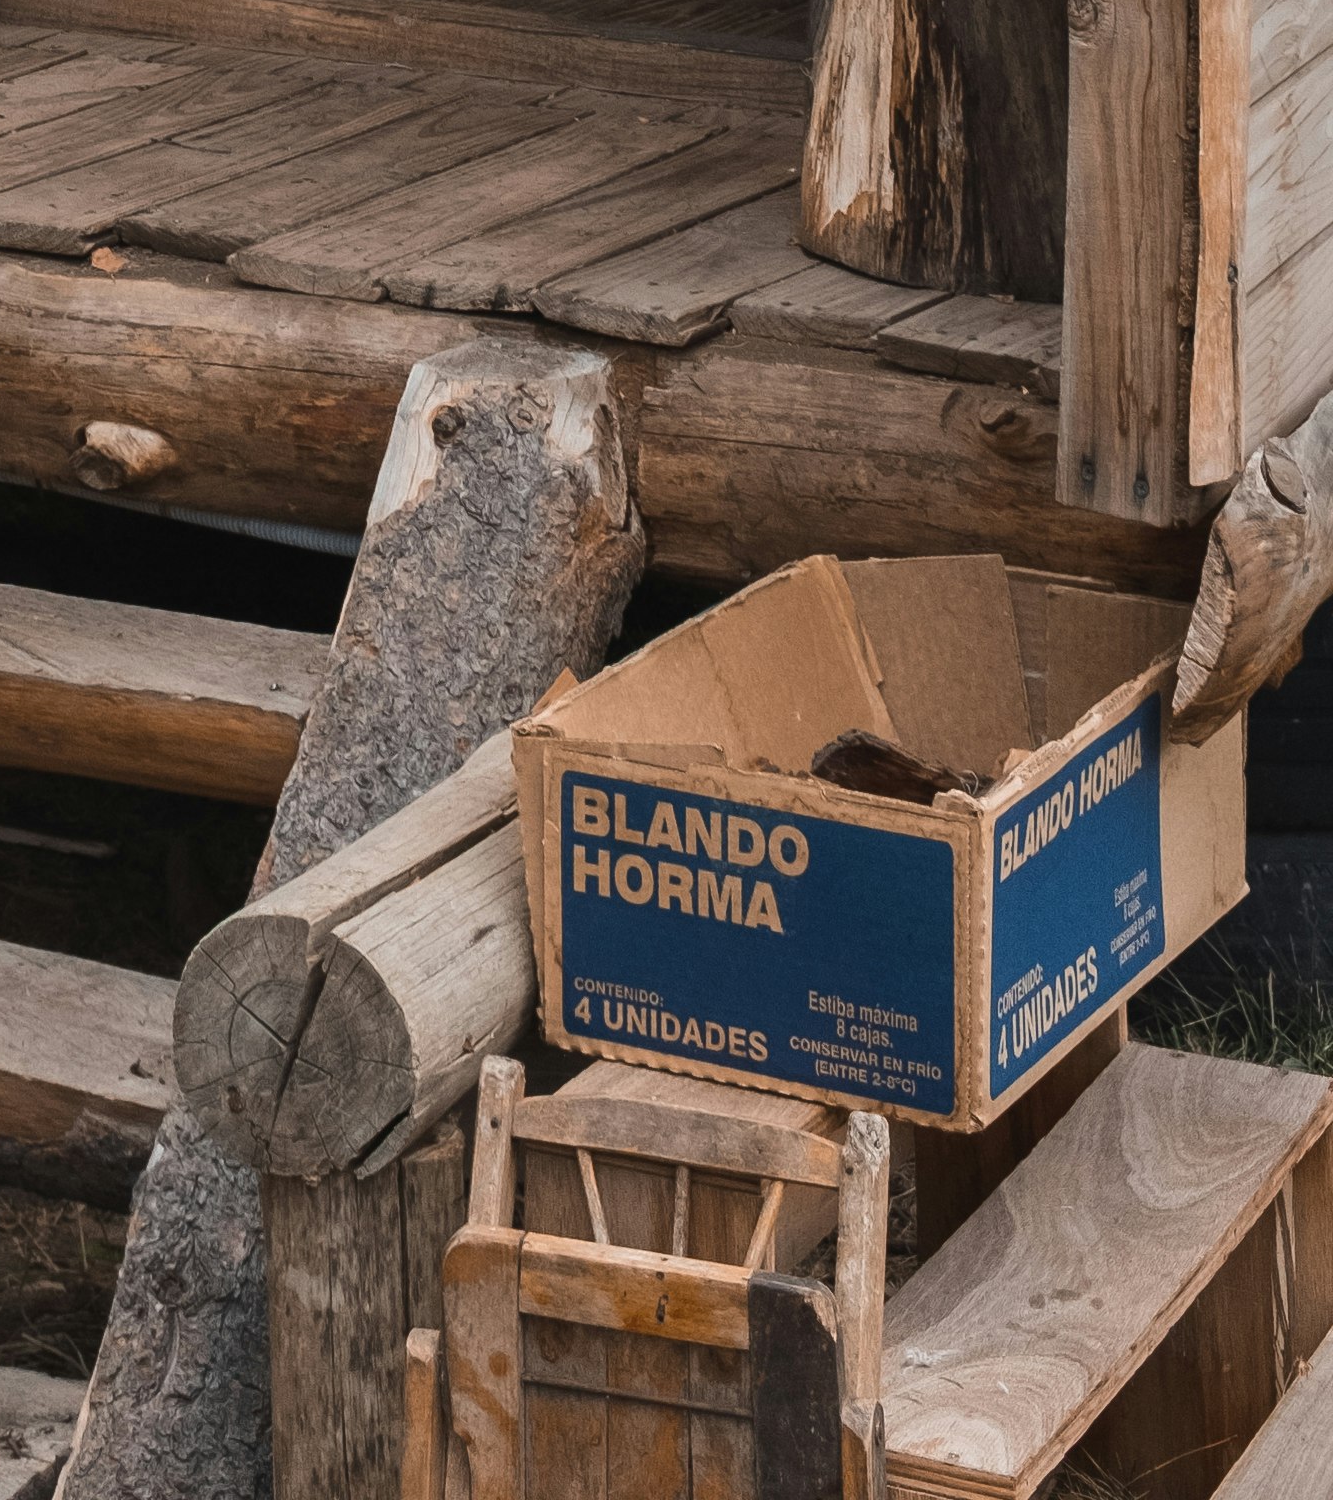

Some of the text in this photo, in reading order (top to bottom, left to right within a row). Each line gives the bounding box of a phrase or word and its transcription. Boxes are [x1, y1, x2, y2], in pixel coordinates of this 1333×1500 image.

[573, 785, 810, 877] BLANDO
[999, 727, 1142, 883] BLANDO HORMA
[573, 844, 784, 934] HORMA
[573, 976, 664, 1008] CONTENIDO:
[808, 989, 918, 1033] Estiba máxima
[997, 963, 1044, 1019] CONTENIDO:
[997, 945, 1098, 1069] 4 UNIDADES
[573, 996, 769, 1063] 4 UNIDADES
[789, 1035, 942, 1080] CONSERVAR EN FRÍO
[836, 1018, 894, 1049] 8 cajas.
[815, 1058, 868, 1084] (ENTRE
